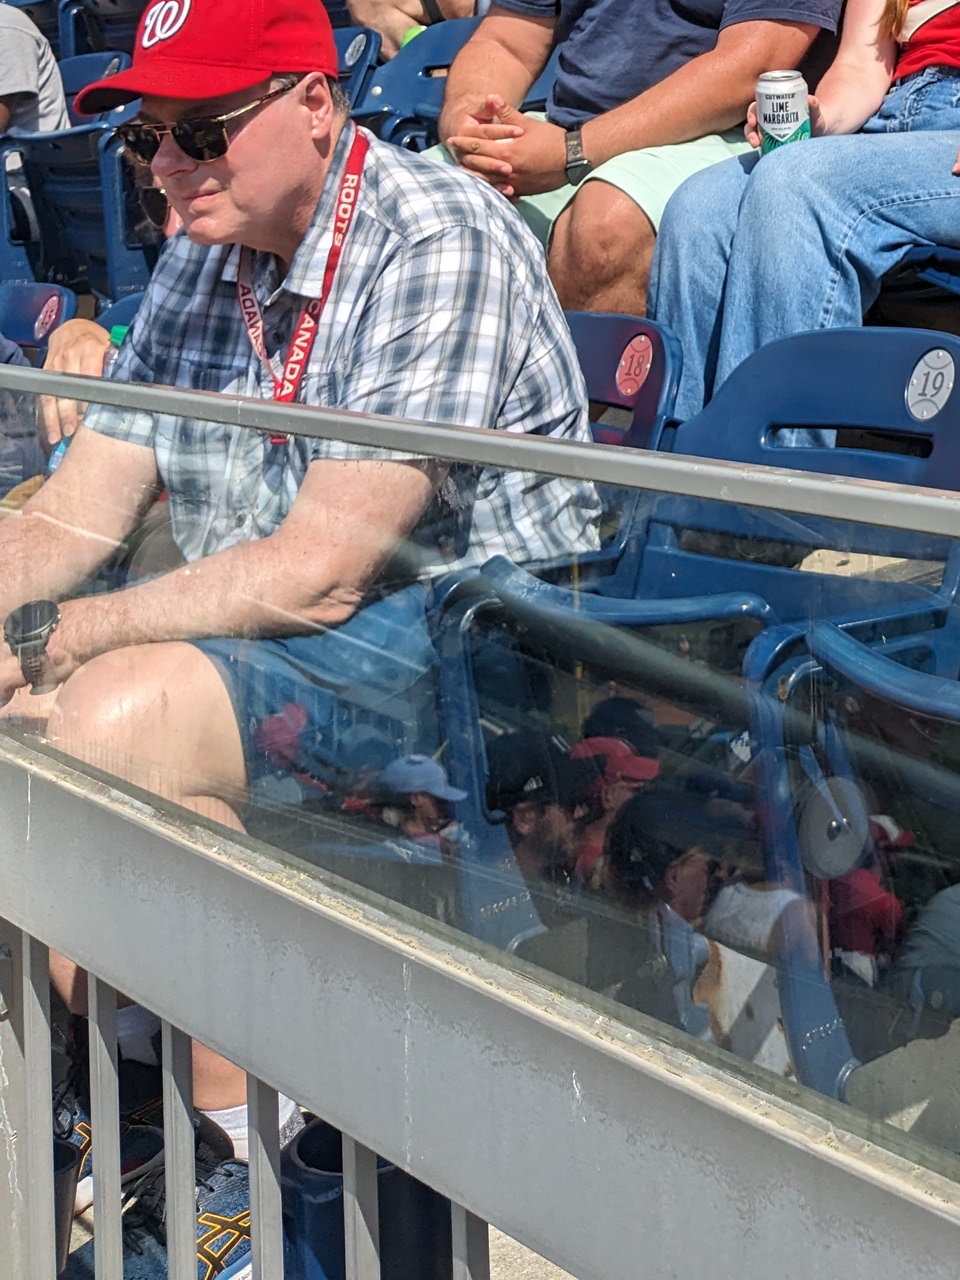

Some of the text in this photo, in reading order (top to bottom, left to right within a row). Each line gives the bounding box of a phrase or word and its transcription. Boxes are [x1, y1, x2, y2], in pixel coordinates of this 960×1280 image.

[763, 111, 799, 125] MARGARITA
[771, 101, 790, 113] LIME
[333, 173, 359, 247] ROOTS
[280, 299, 321, 396] CANADA
[625, 353, 645, 377] 18
[918, 370, 945, 398] 19
